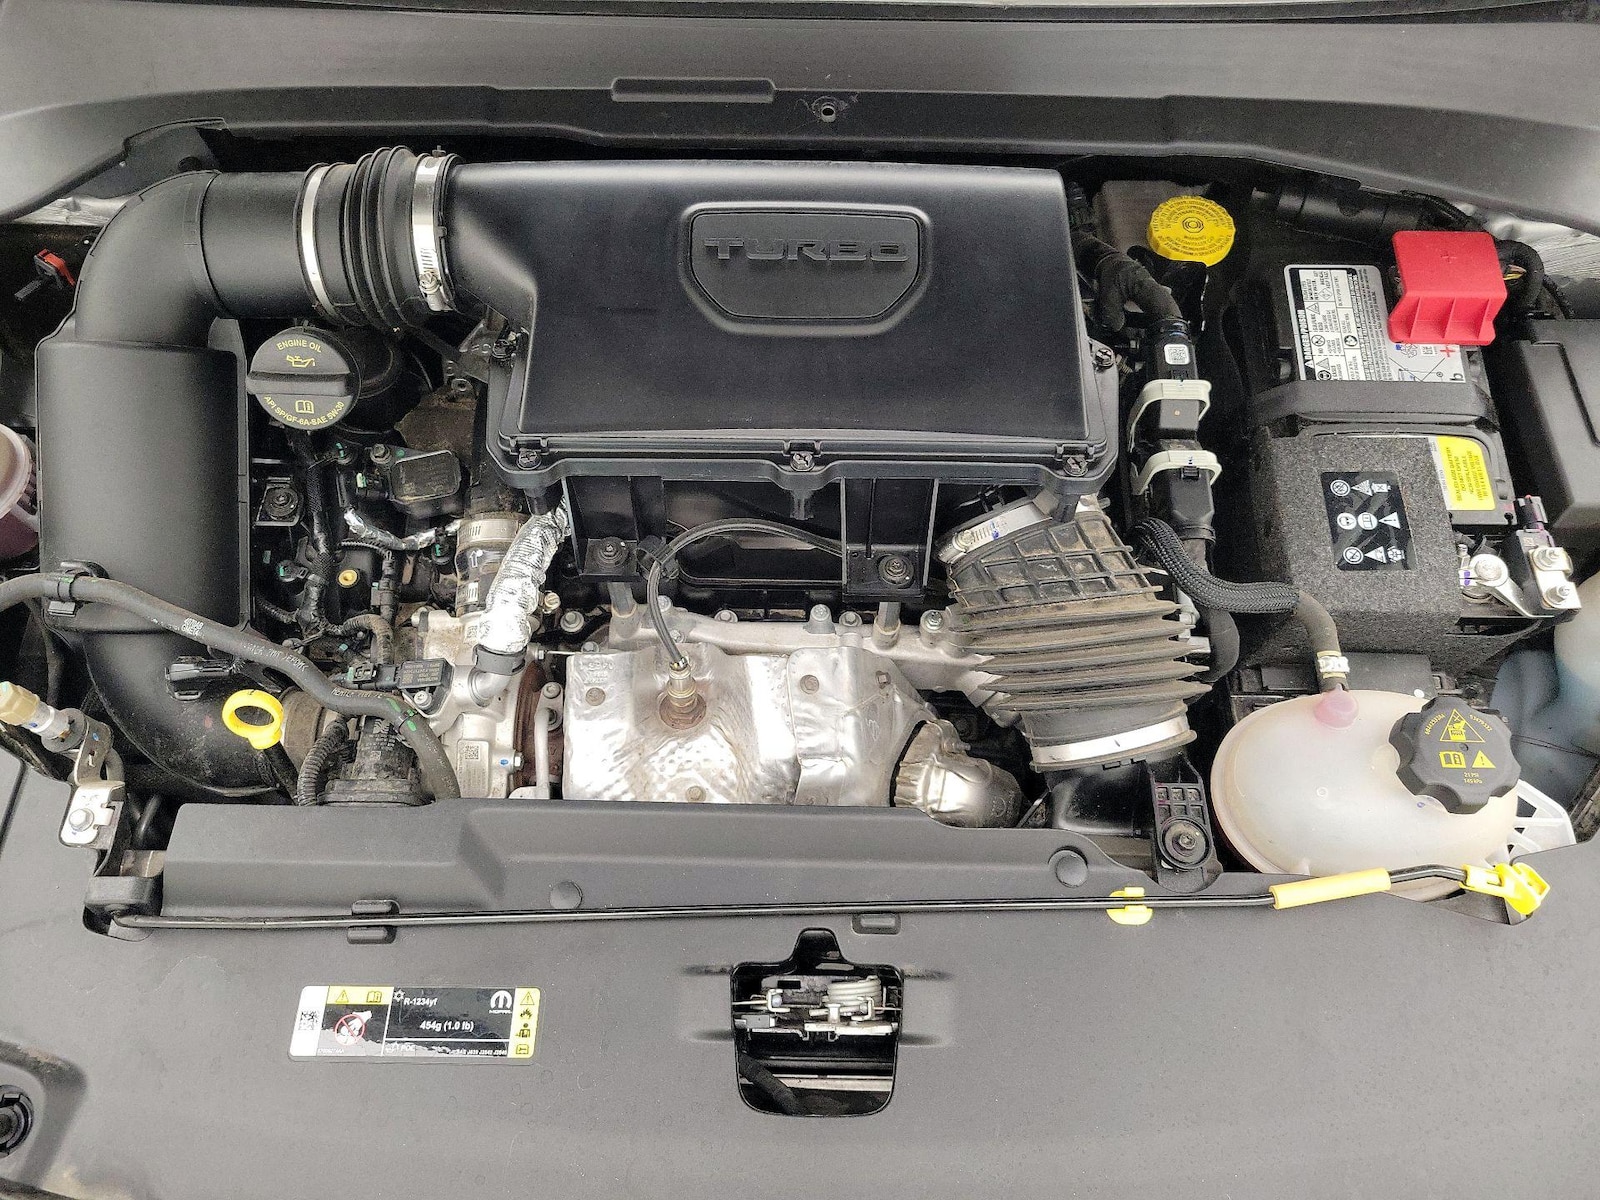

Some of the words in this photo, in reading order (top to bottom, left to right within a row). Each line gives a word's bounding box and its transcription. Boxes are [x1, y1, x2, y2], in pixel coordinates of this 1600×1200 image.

[704, 237, 909, 261] TURBO
[276, 339, 308, 350] ENGINE
[309, 342, 322, 353] OIL
[263, 395, 277, 409] API
[327, 401, 345, 420] 5W-30
[403, 997, 438, 1006] R-1234yf
[420, 1021, 442, 1032] 454g
[443, 1021, 460, 1031] (1.0
[461, 1021, 475, 1032] lb)
